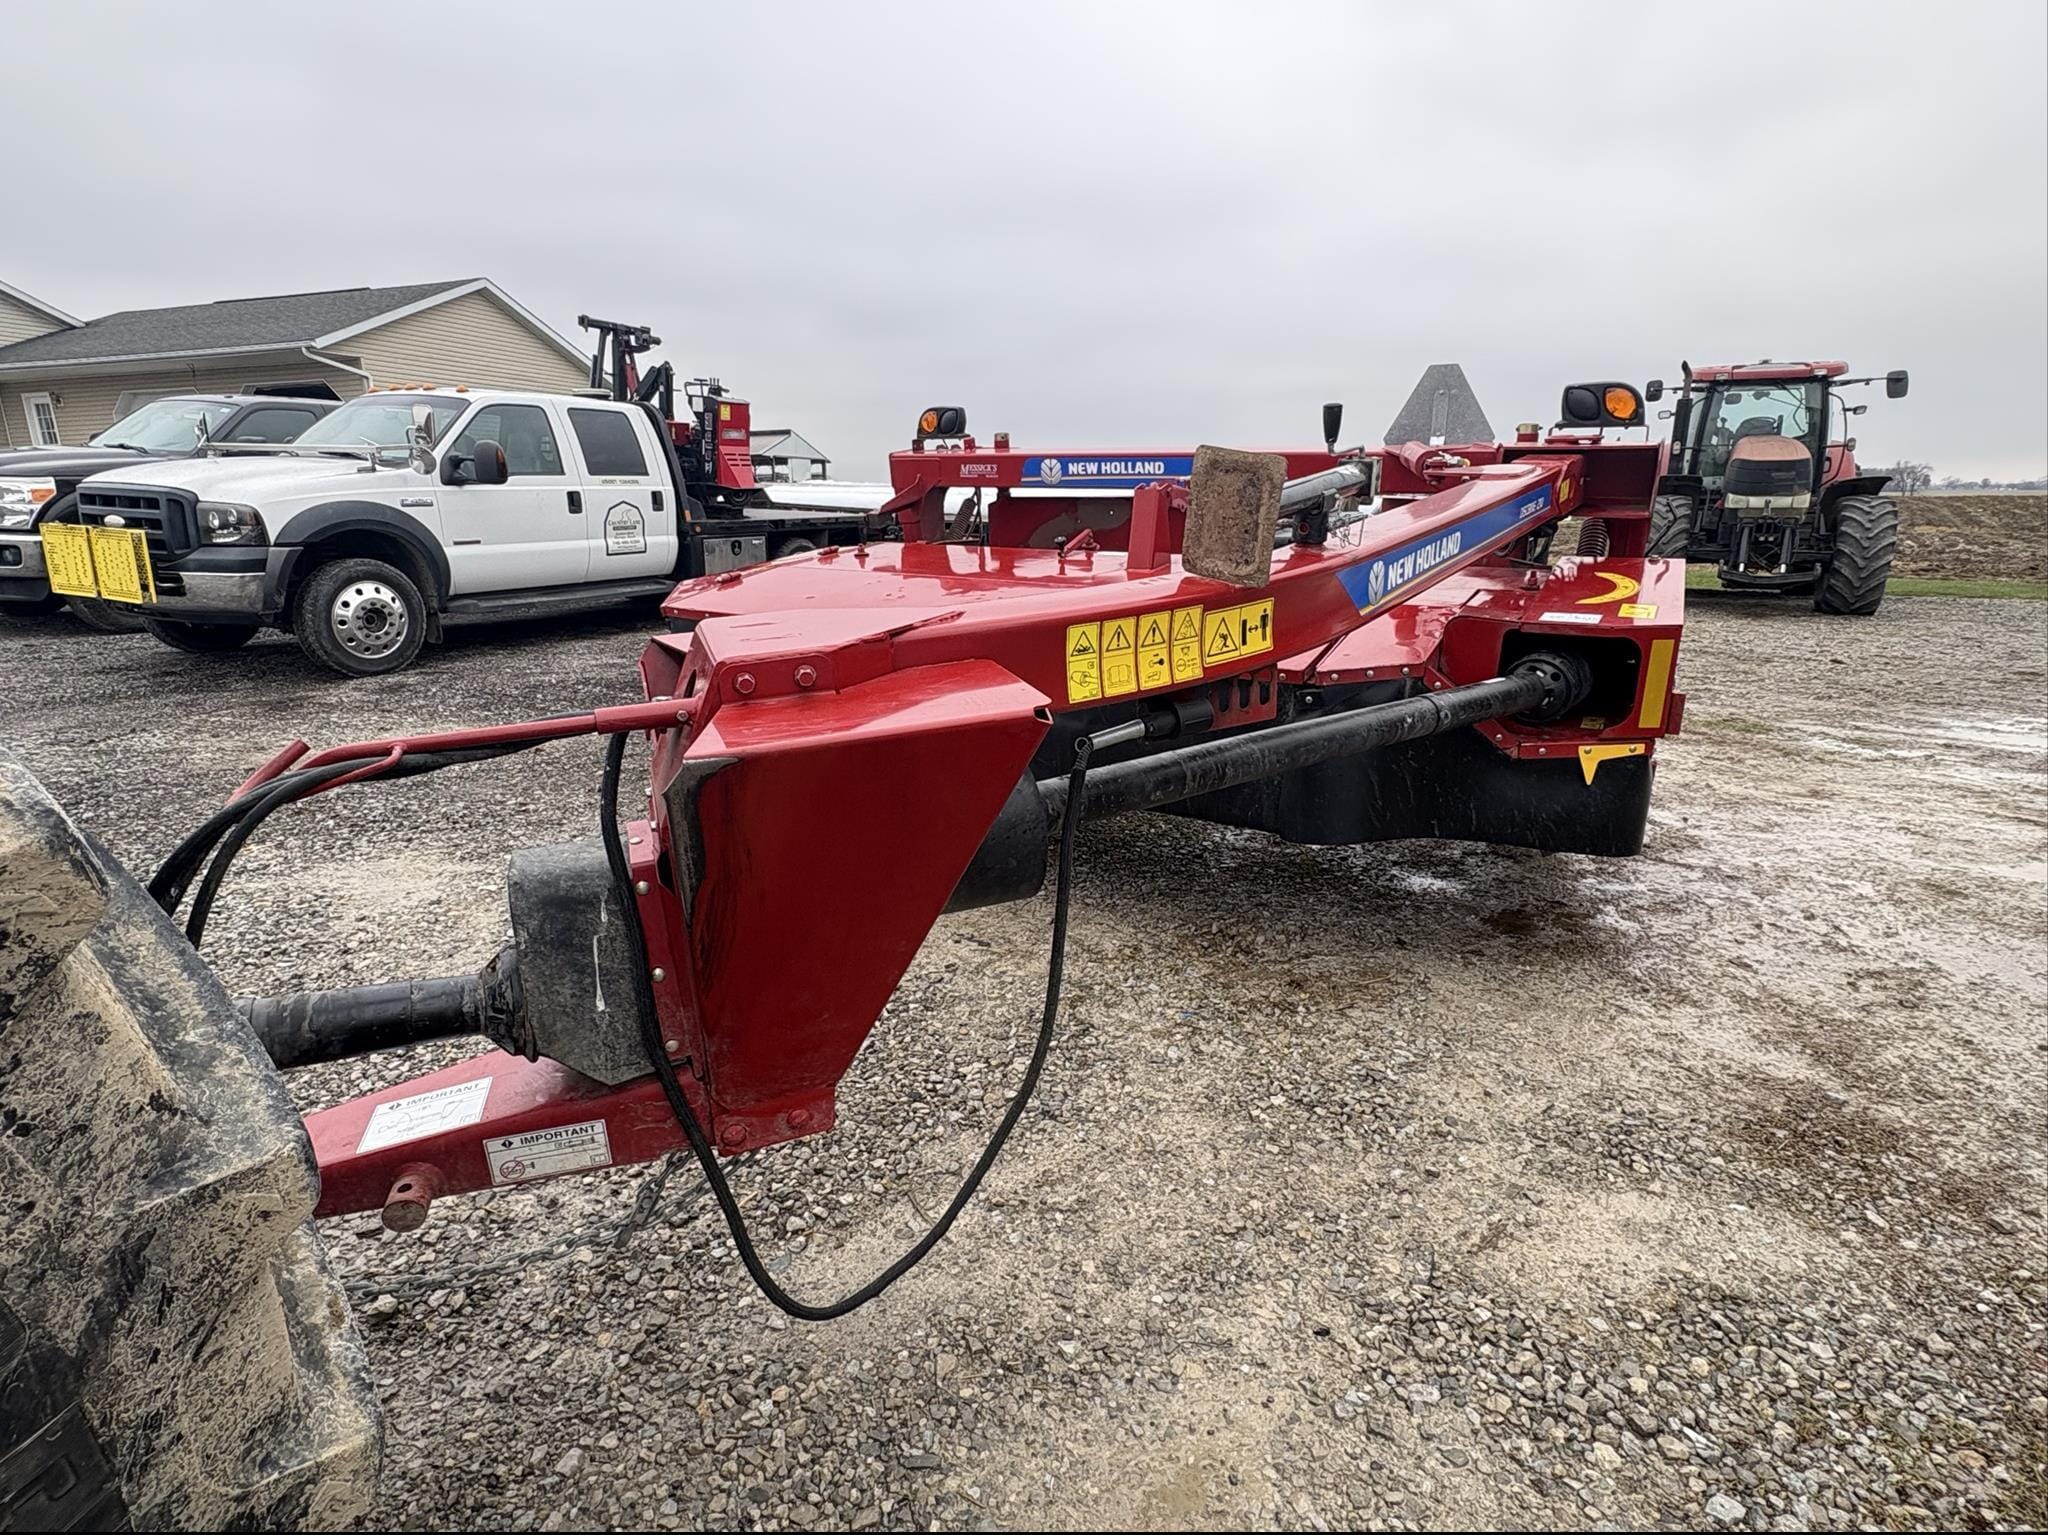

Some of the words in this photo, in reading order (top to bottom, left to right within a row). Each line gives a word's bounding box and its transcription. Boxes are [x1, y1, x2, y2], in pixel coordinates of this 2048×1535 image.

[1068, 462, 1098, 475] NEW
[1101, 461, 1164, 475] HOLLAND
[1387, 552, 1416, 591] NEW
[1415, 531, 1462, 574] HOLLAND
[406, 1083, 481, 1107] IMPORTANT
[520, 1125, 596, 1145] IMPORTANT
